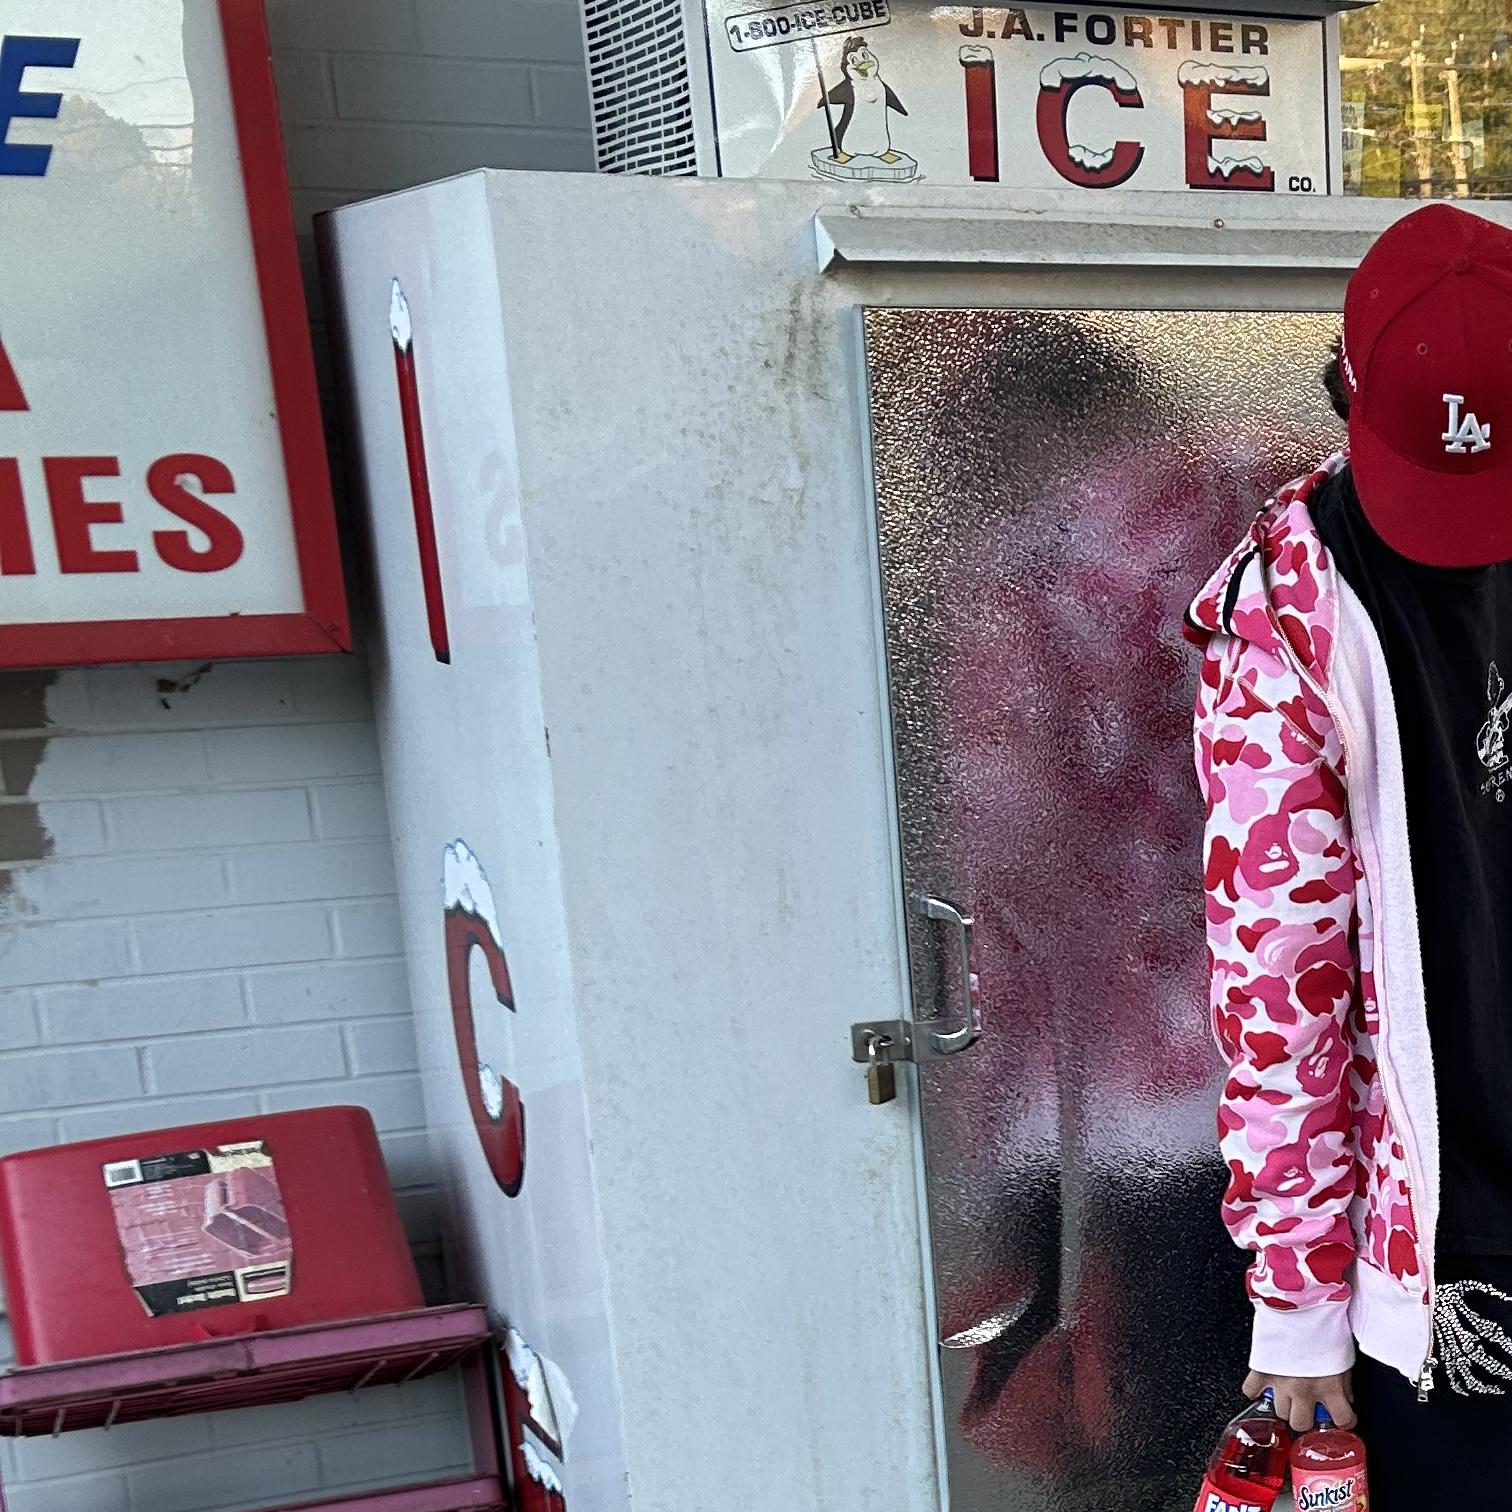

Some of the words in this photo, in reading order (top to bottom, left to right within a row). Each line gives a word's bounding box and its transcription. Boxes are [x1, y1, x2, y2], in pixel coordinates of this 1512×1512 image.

[729, 0, 887, 44] 1-800-ICE-CUBE
[958, 44, 1276, 192] ICE
[1288, 175, 1317, 193] CO.
[1441, 393, 1491, 454] LA
[1299, 1479, 1355, 1511] Sunkist
